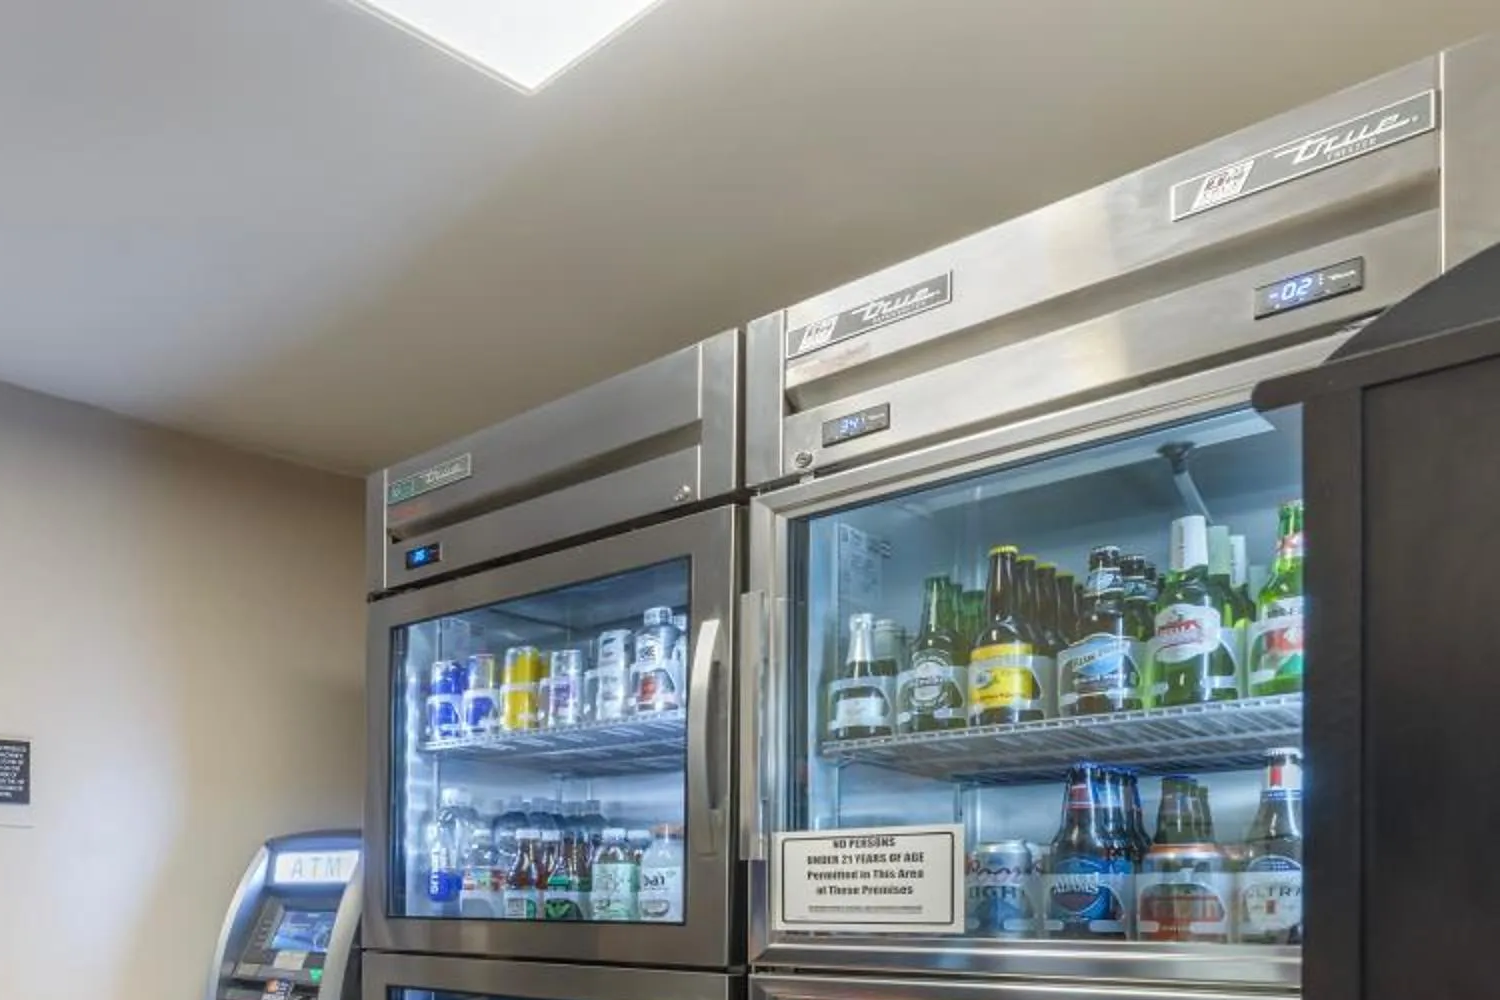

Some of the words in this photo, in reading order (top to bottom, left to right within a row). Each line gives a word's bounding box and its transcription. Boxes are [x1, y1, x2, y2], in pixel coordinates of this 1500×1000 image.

[833, 839, 847, 849] NO
[849, 837, 896, 849] PERSONS
[807, 855, 839, 865] UNDER
[841, 854, 853, 865] 21
[854, 853, 887, 864] YEARS
[903, 851, 924, 863] AGE
[290, 856, 342, 880] ATM
[807, 870, 858, 881] Permitted
[873, 869, 897, 879] This
[898, 869, 924, 879] Area
[861, 885, 914, 895] Premises
